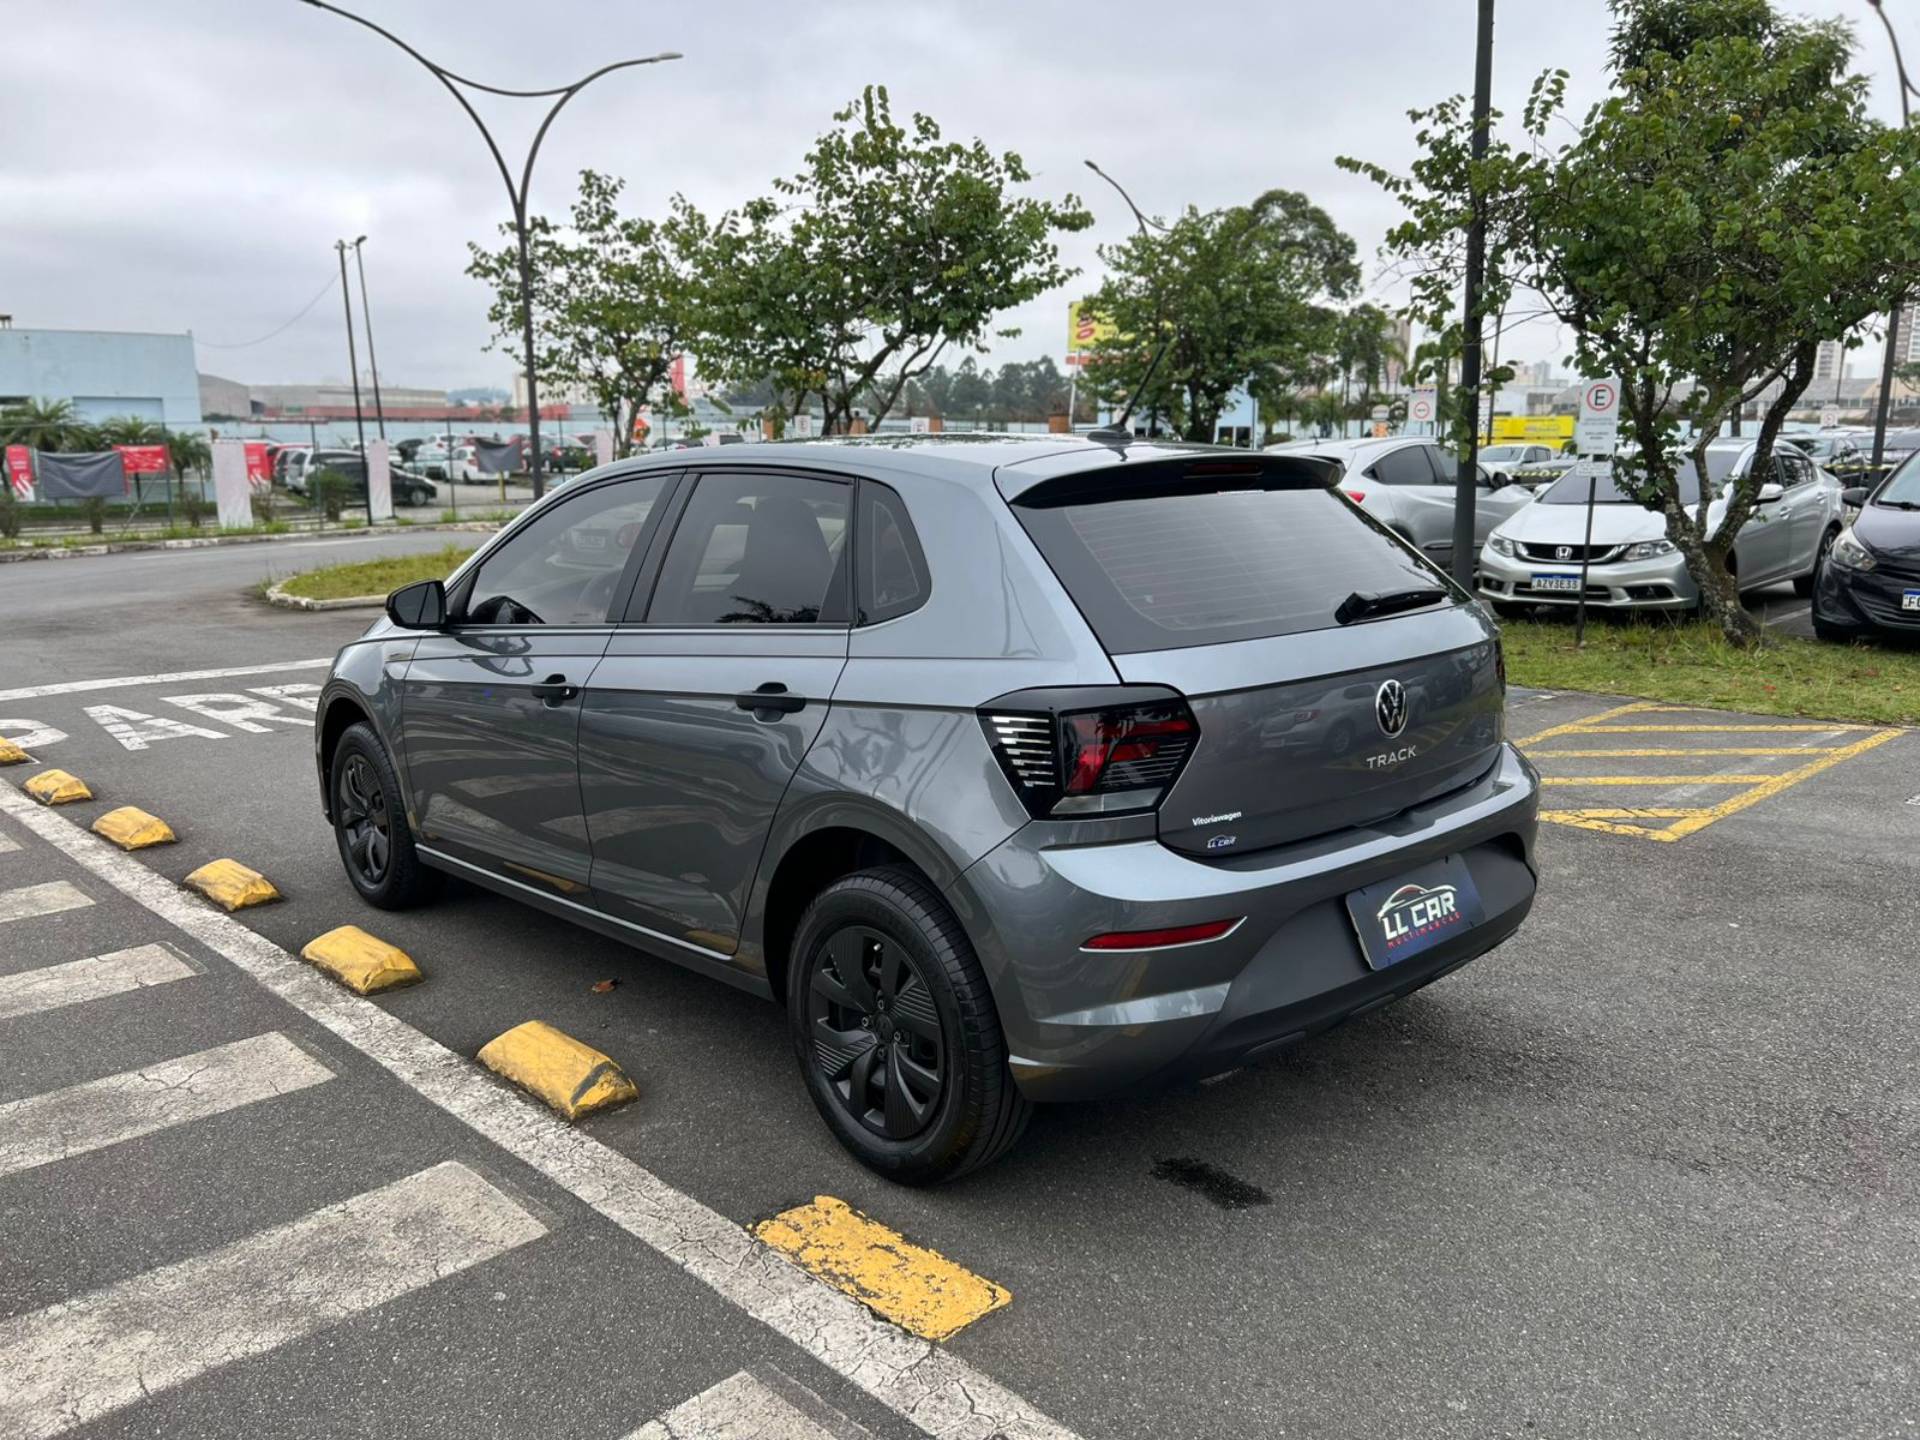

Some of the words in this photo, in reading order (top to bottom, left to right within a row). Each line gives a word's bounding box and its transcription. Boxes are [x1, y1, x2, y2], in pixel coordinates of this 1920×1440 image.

[1594, 388, 1607, 406] E
[1366, 744, 1417, 769] TRACK
[1382, 912, 1409, 941] LL
[1410, 891, 1456, 928] CAR
